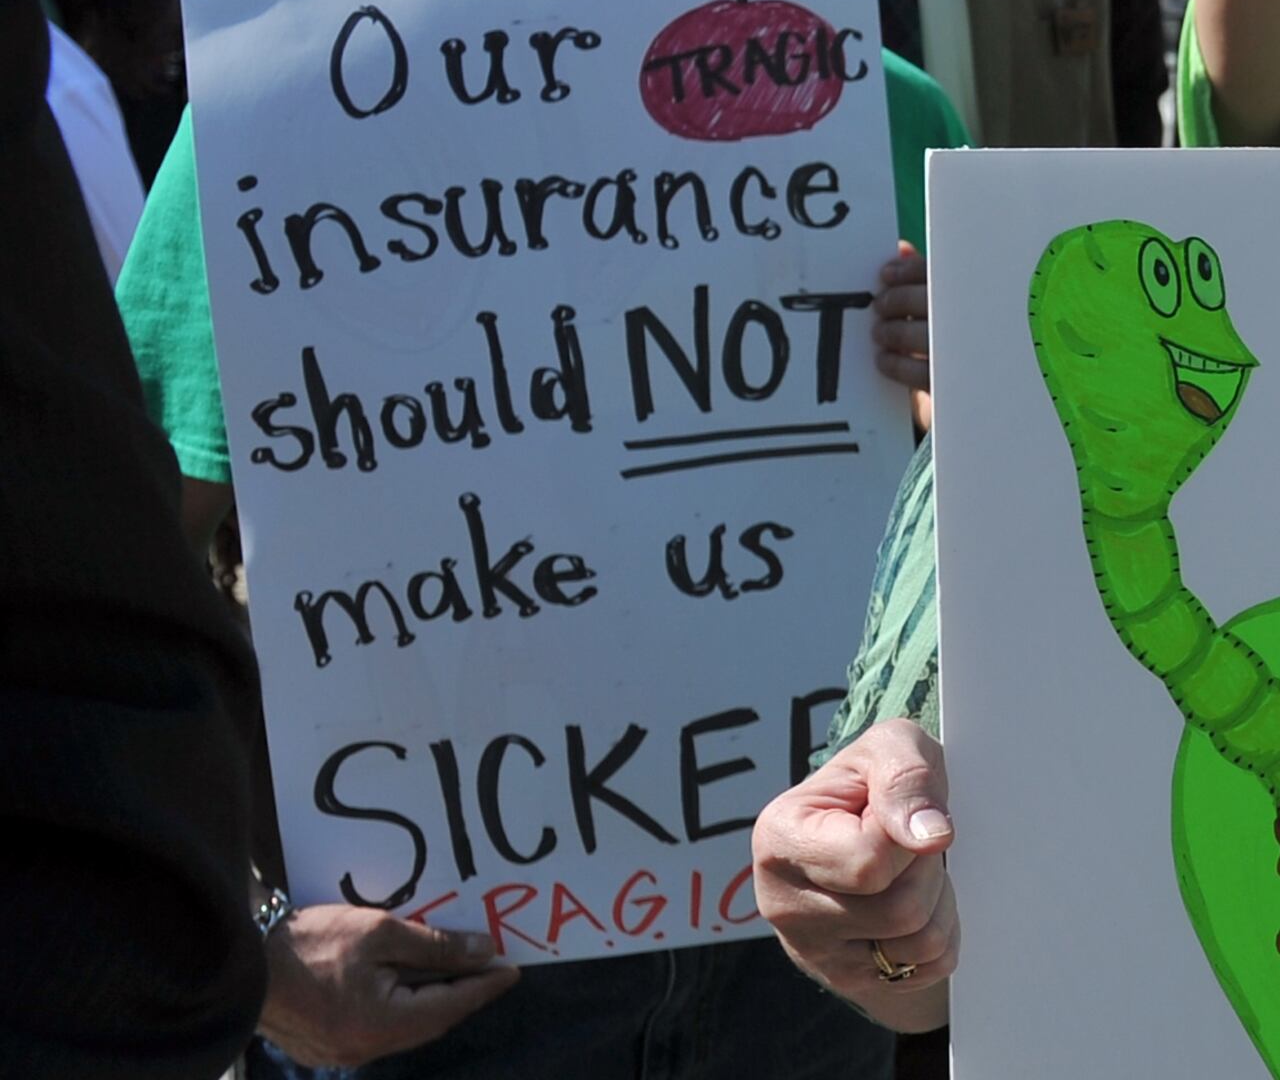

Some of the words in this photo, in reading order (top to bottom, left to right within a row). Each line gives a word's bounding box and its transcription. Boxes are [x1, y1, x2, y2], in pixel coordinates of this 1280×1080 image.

[330, 6, 601, 119] Our
[641, 25, 869, 105] TRAGIC
[236, 162, 850, 294] insurance
[251, 304, 593, 473] should
[624, 284, 874, 423] NOT
[294, 491, 597, 668] make
[665, 521, 794, 601] us
